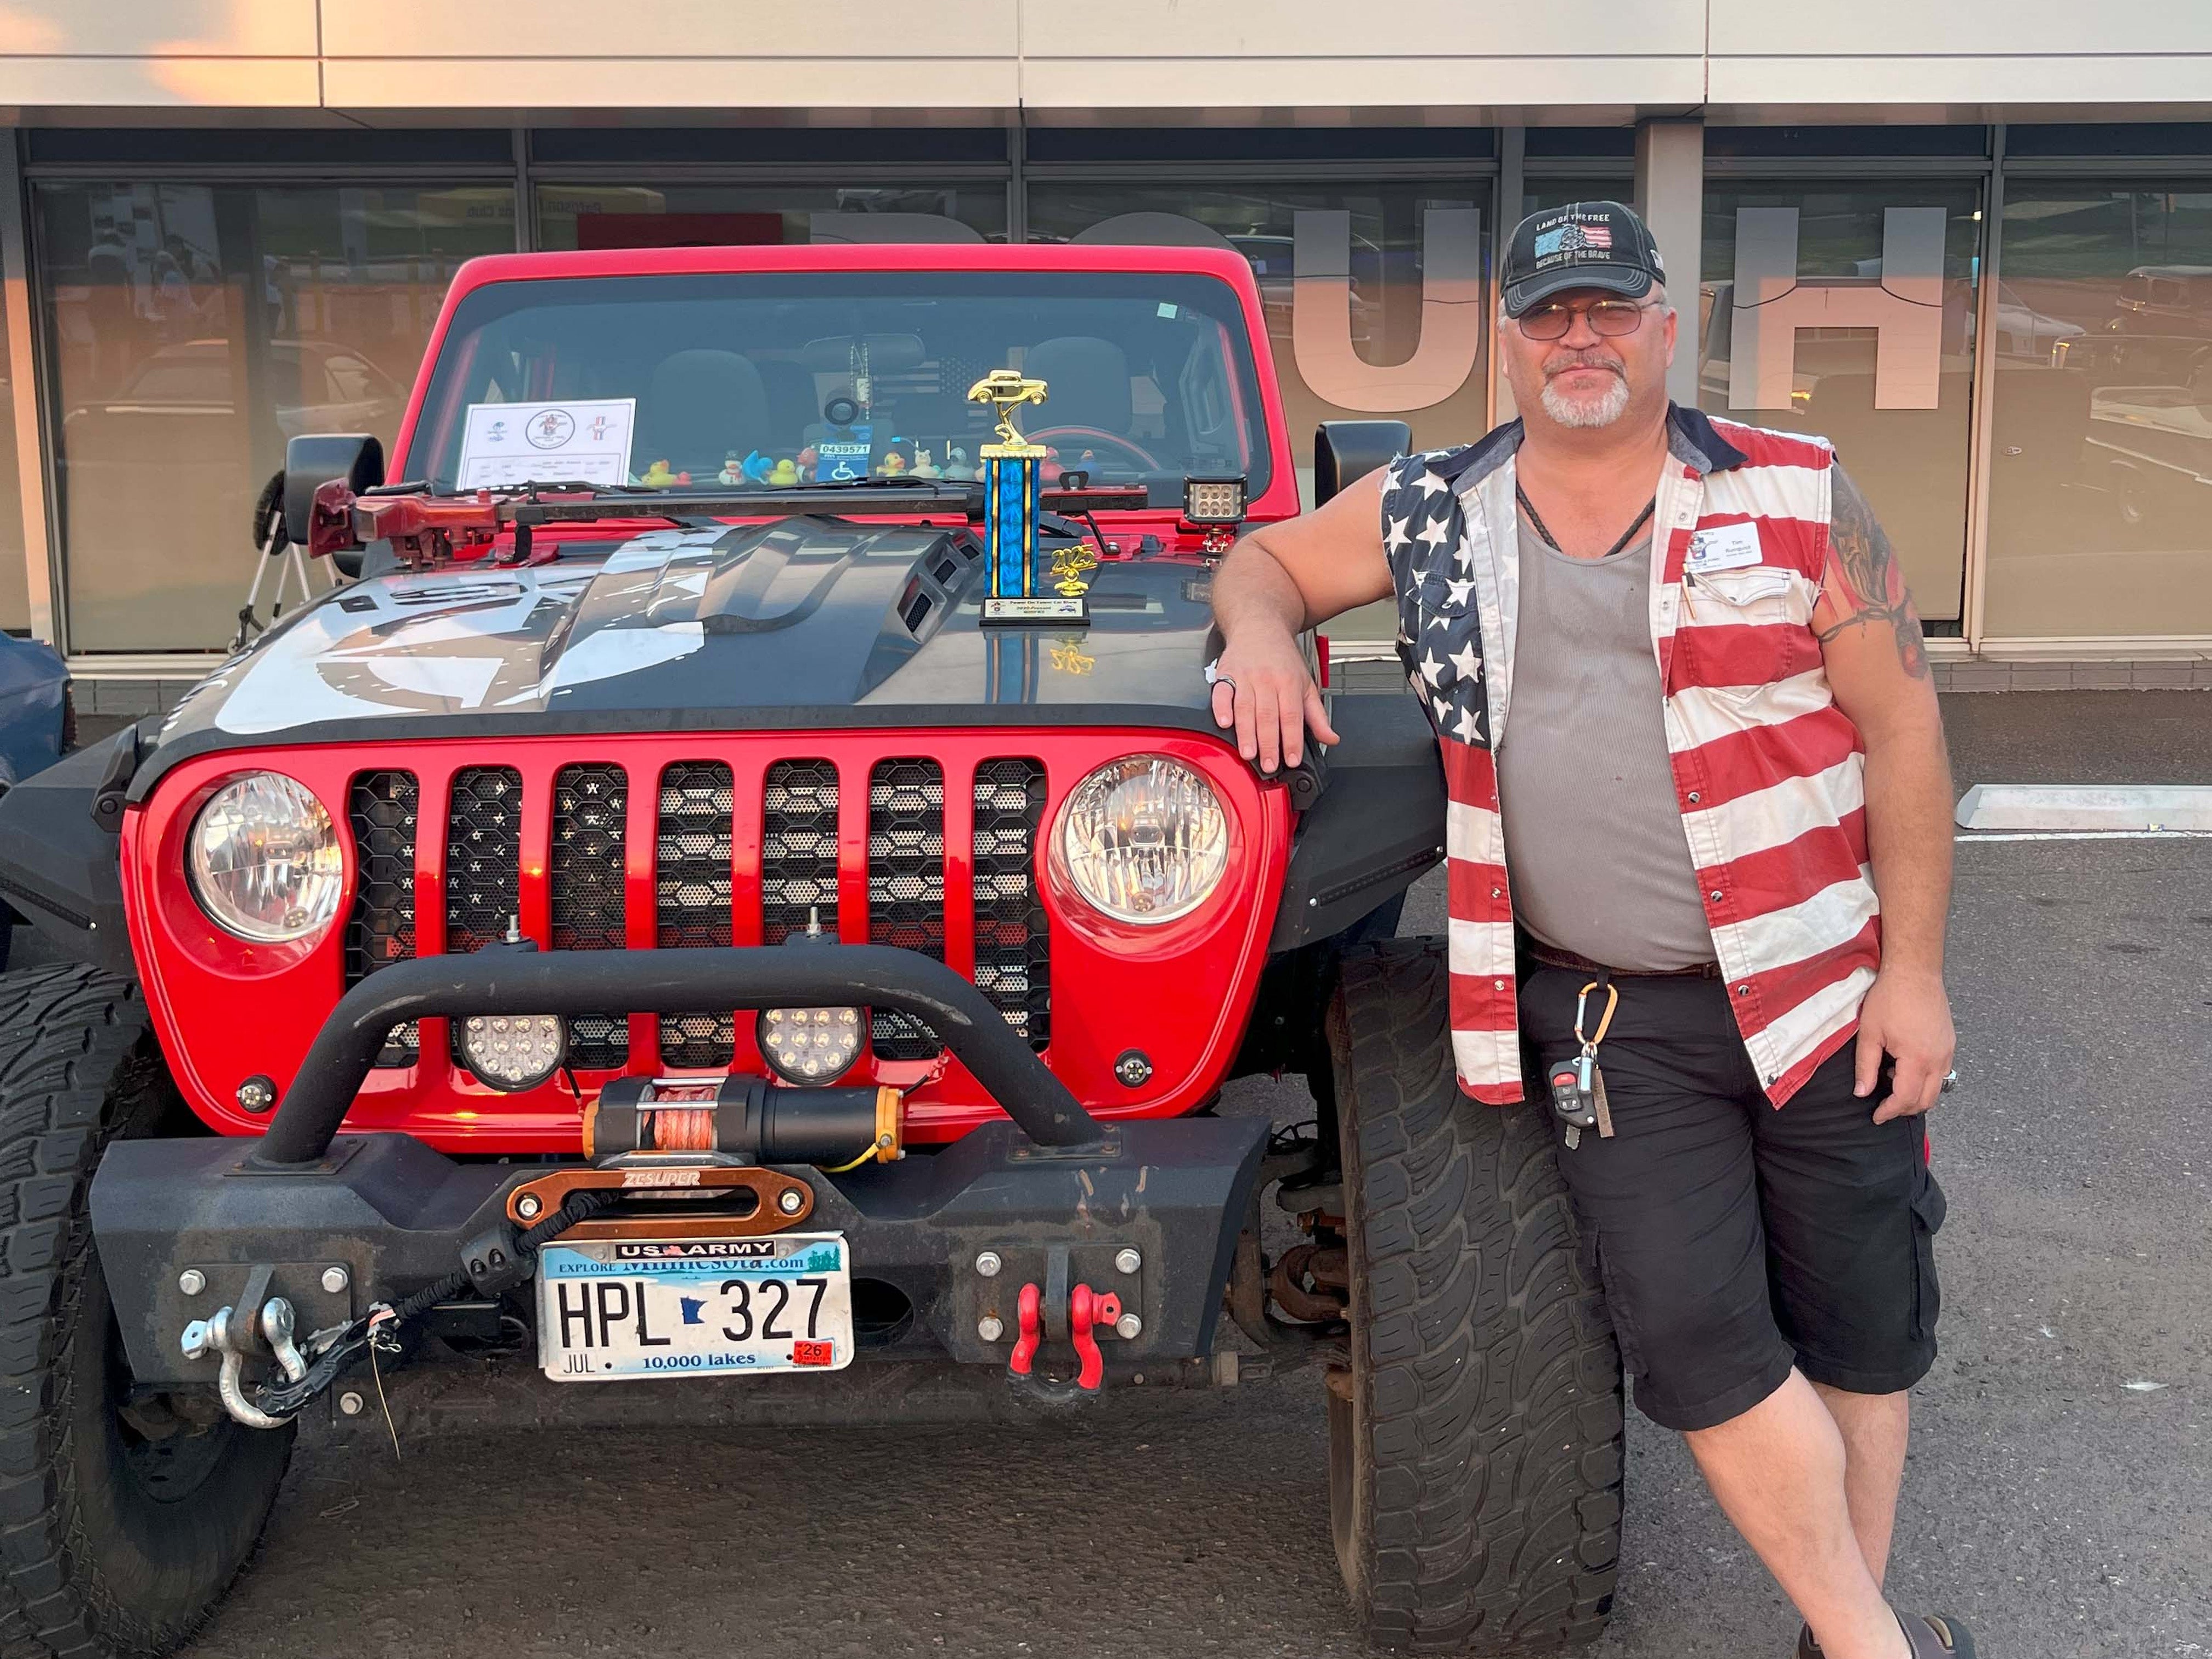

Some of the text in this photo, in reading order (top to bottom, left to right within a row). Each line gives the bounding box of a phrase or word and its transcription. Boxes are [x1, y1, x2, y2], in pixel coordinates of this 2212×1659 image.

[1536, 213, 1610, 231] LAND OF THE FREE
[1536, 253, 1563, 269] BECAUSE
[1574, 250, 1587, 258] THE
[1588, 250, 1611, 259] BRAVE
[823, 445, 867, 454] 0439571
[624, 1171, 701, 1186] ZESUPER
[621, 1242, 772, 1256] US ARMY
[559, 1263, 616, 1273] EXPLORE
[557, 1278, 828, 1348] HPL 327
[803, 1343, 822, 1357] 26
[563, 1353, 596, 1374] JUL
[642, 1352, 756, 1370] 10,000 lakes
